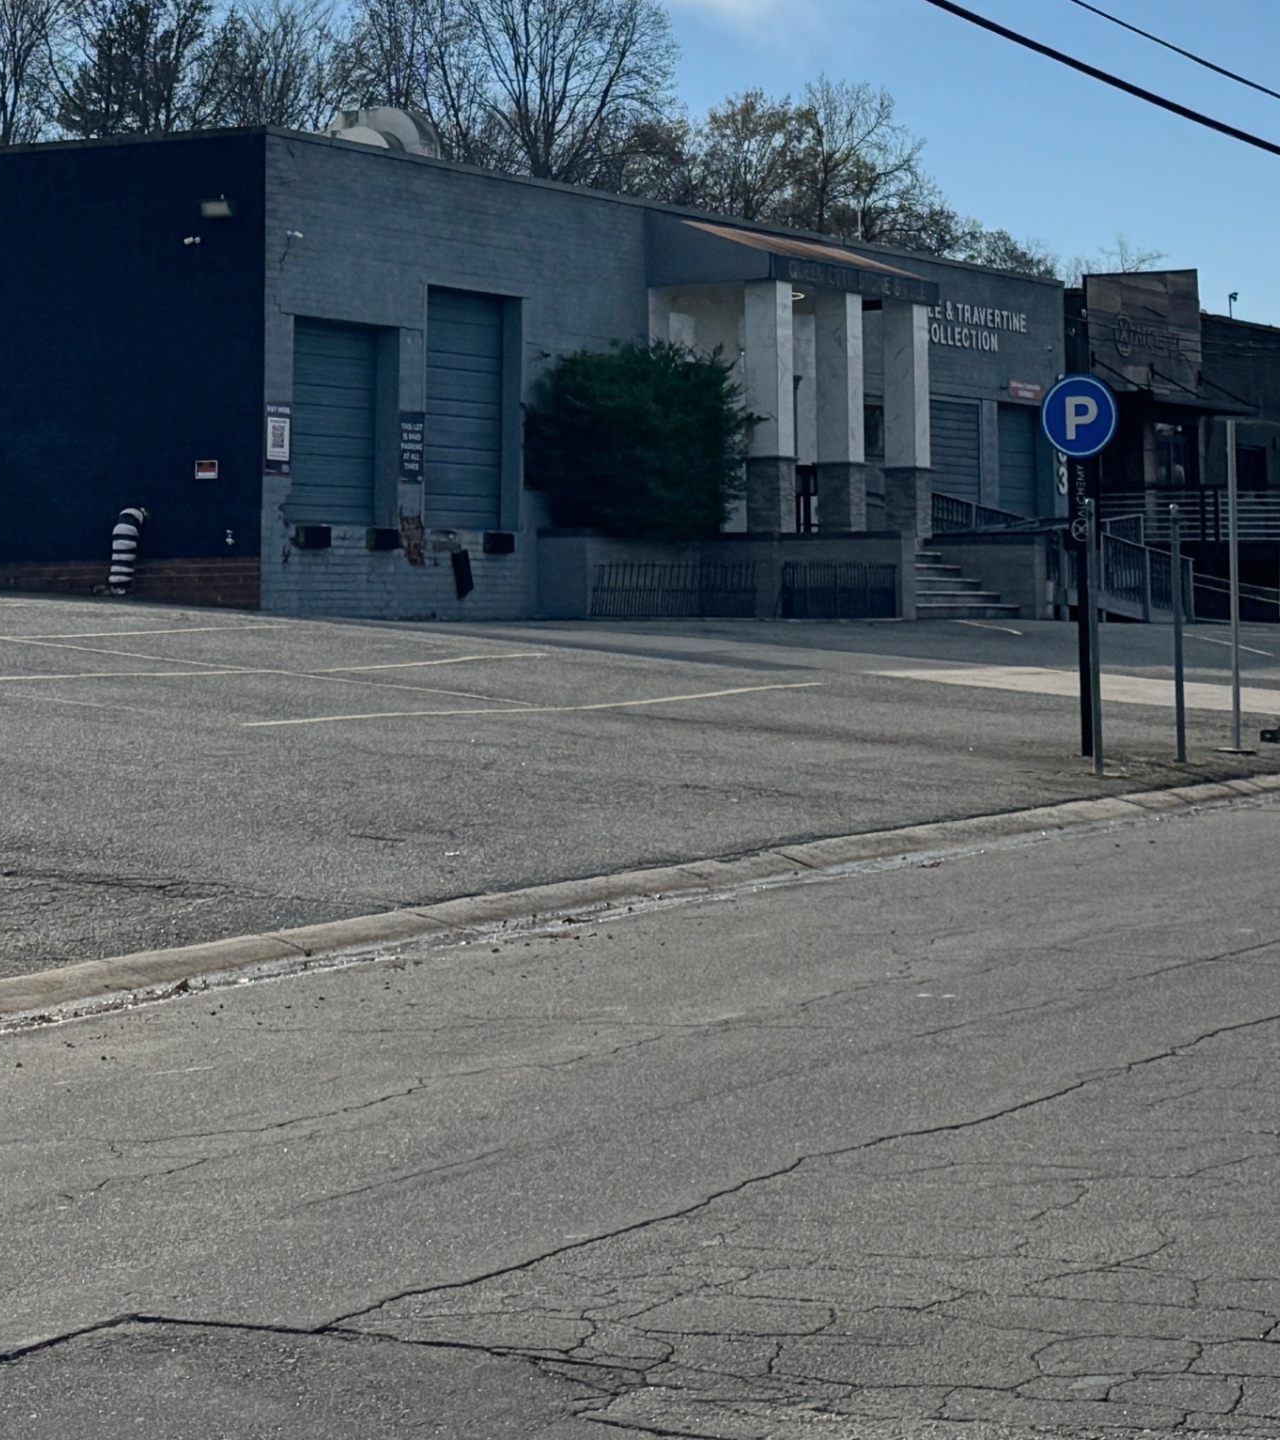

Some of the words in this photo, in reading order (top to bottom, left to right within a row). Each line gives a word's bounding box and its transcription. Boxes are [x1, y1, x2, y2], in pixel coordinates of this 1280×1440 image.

[946, 300, 955, 321] &
[956, 302, 1028, 333] TRAVERTINE
[1065, 396, 1098, 440] P
[1075, 464, 1086, 518] ALCHEMY
